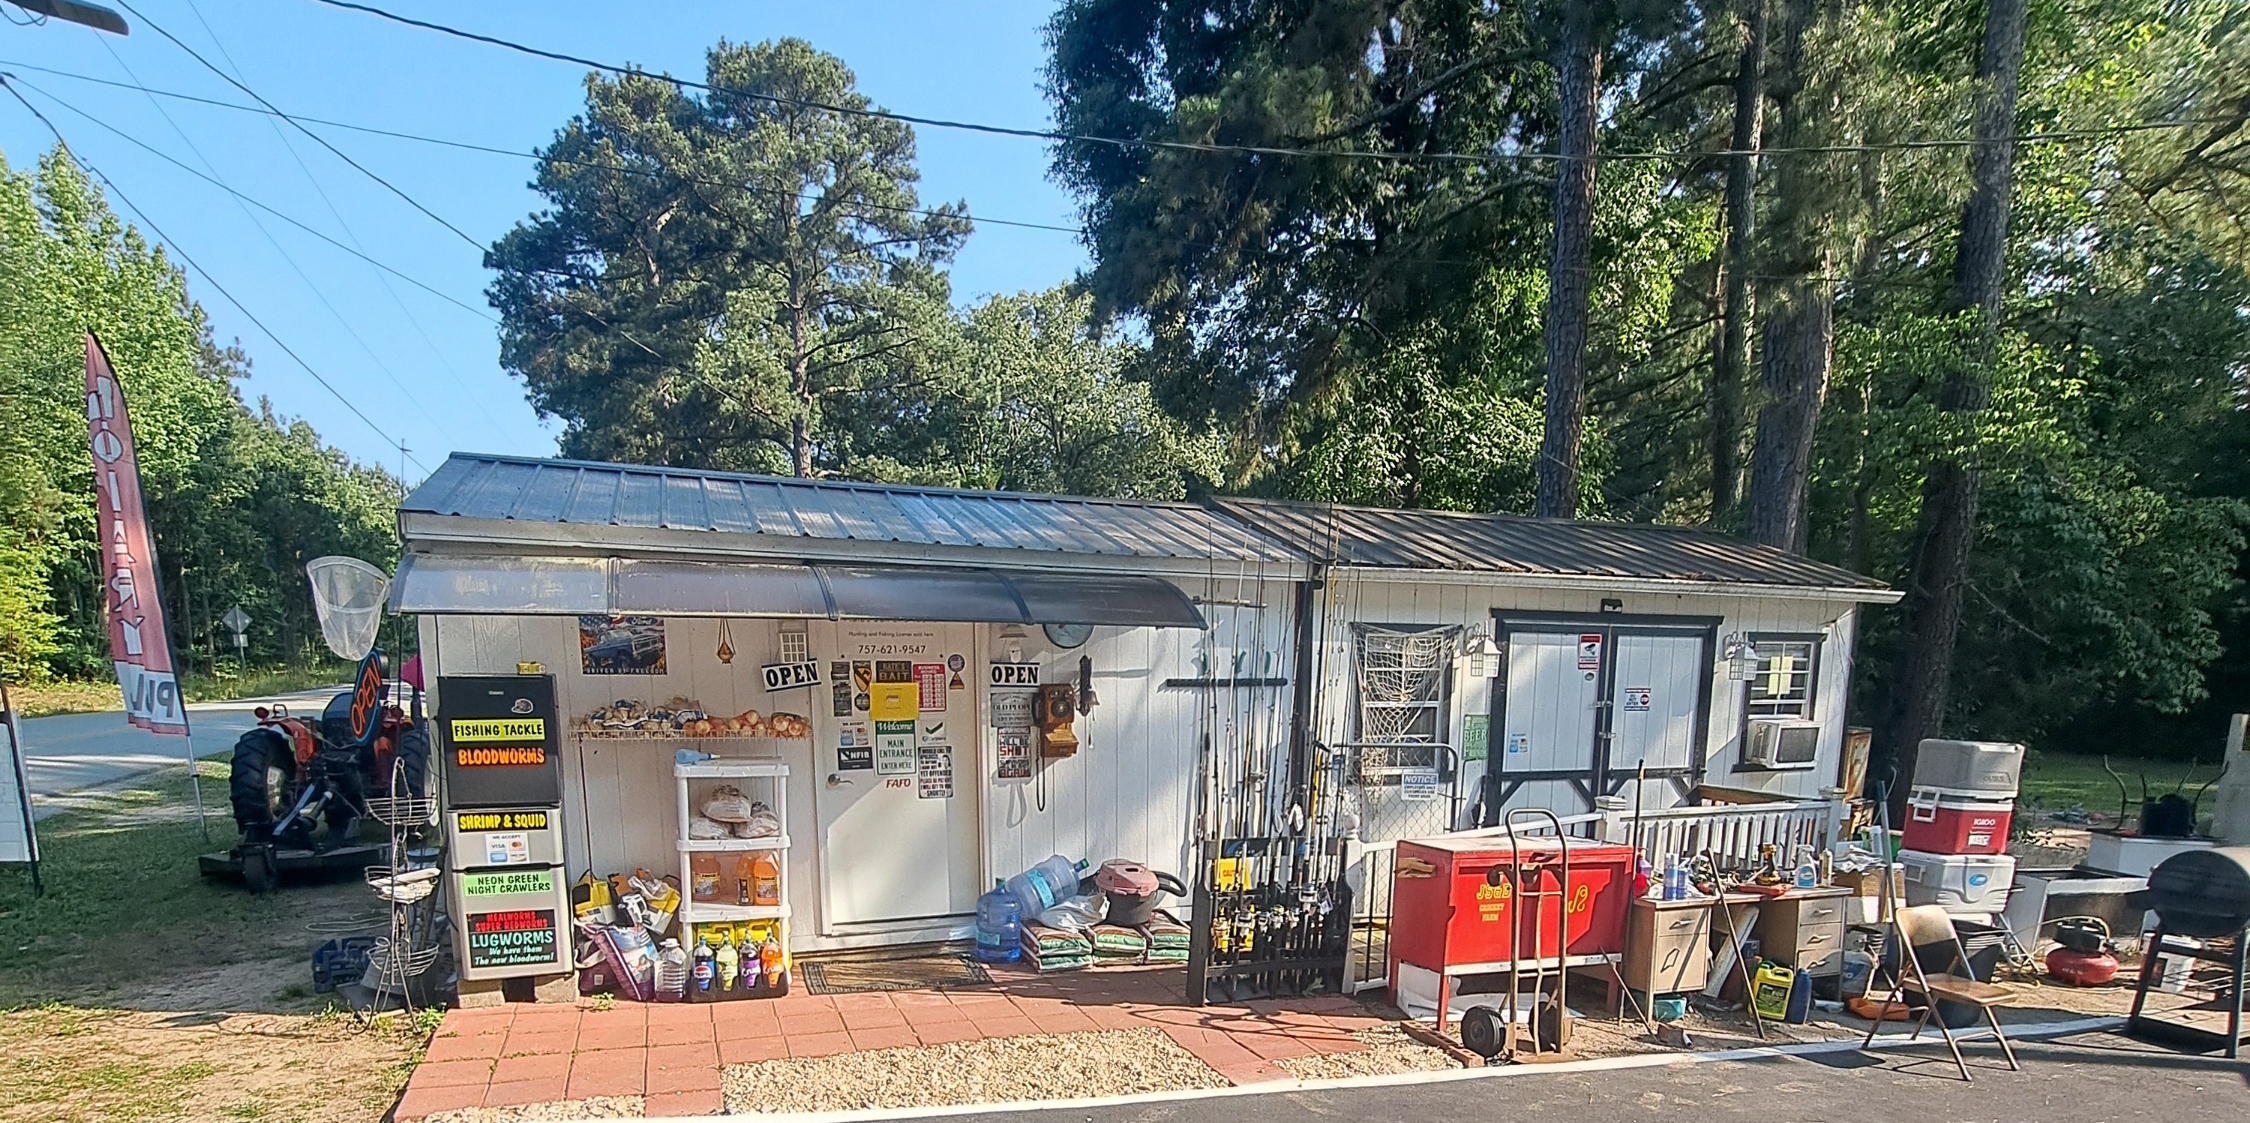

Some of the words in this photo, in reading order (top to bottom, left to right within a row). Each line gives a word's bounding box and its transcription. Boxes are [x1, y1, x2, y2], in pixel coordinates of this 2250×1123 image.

[631, 616, 653, 625] Ford
[858, 644, 926, 654] 757-621-9547
[766, 662, 818, 687] OPEN
[879, 672, 909, 681] BAIT
[991, 666, 1038, 683] OPEN
[352, 657, 381, 735] OPEN
[454, 724, 500, 737] FISHING
[504, 723, 543, 736] TACKLE
[877, 721, 914, 731] Welcome
[1464, 730, 1486, 742] BEER
[887, 739, 905, 748] MAIN
[458, 747, 545, 765] BLOODWORMS
[879, 748, 914, 758] ENTRANCE
[999, 746, 1029, 756] SHOT
[881, 762, 898, 770] ENTER
[899, 761, 913, 769] HERE
[886, 778, 911, 789] FAFO
[1405, 775, 1436, 784] NOTICE
[460, 814, 502, 830] SHRIMP
[503, 813, 513, 828] &
[514, 813, 547, 829] SQUID
[477, 875, 504, 886] NEON
[507, 873, 540, 884] GREEN
[468, 885, 497, 895] NIGHT
[500, 882, 551, 893] CRAWLERS
[486, 911, 536, 922] MEALWORMS
[475, 921, 501, 932] SUPER
[503, 918, 548, 930] REDWORMS
[471, 930, 554, 948] LUGWORMS
[489, 947, 501, 955] We
[503, 945, 521, 954] have
[523, 944, 543, 953] them
[474, 957, 489, 966] The
[491, 956, 508, 964] new
[509, 952, 555, 963] bloodworm!
